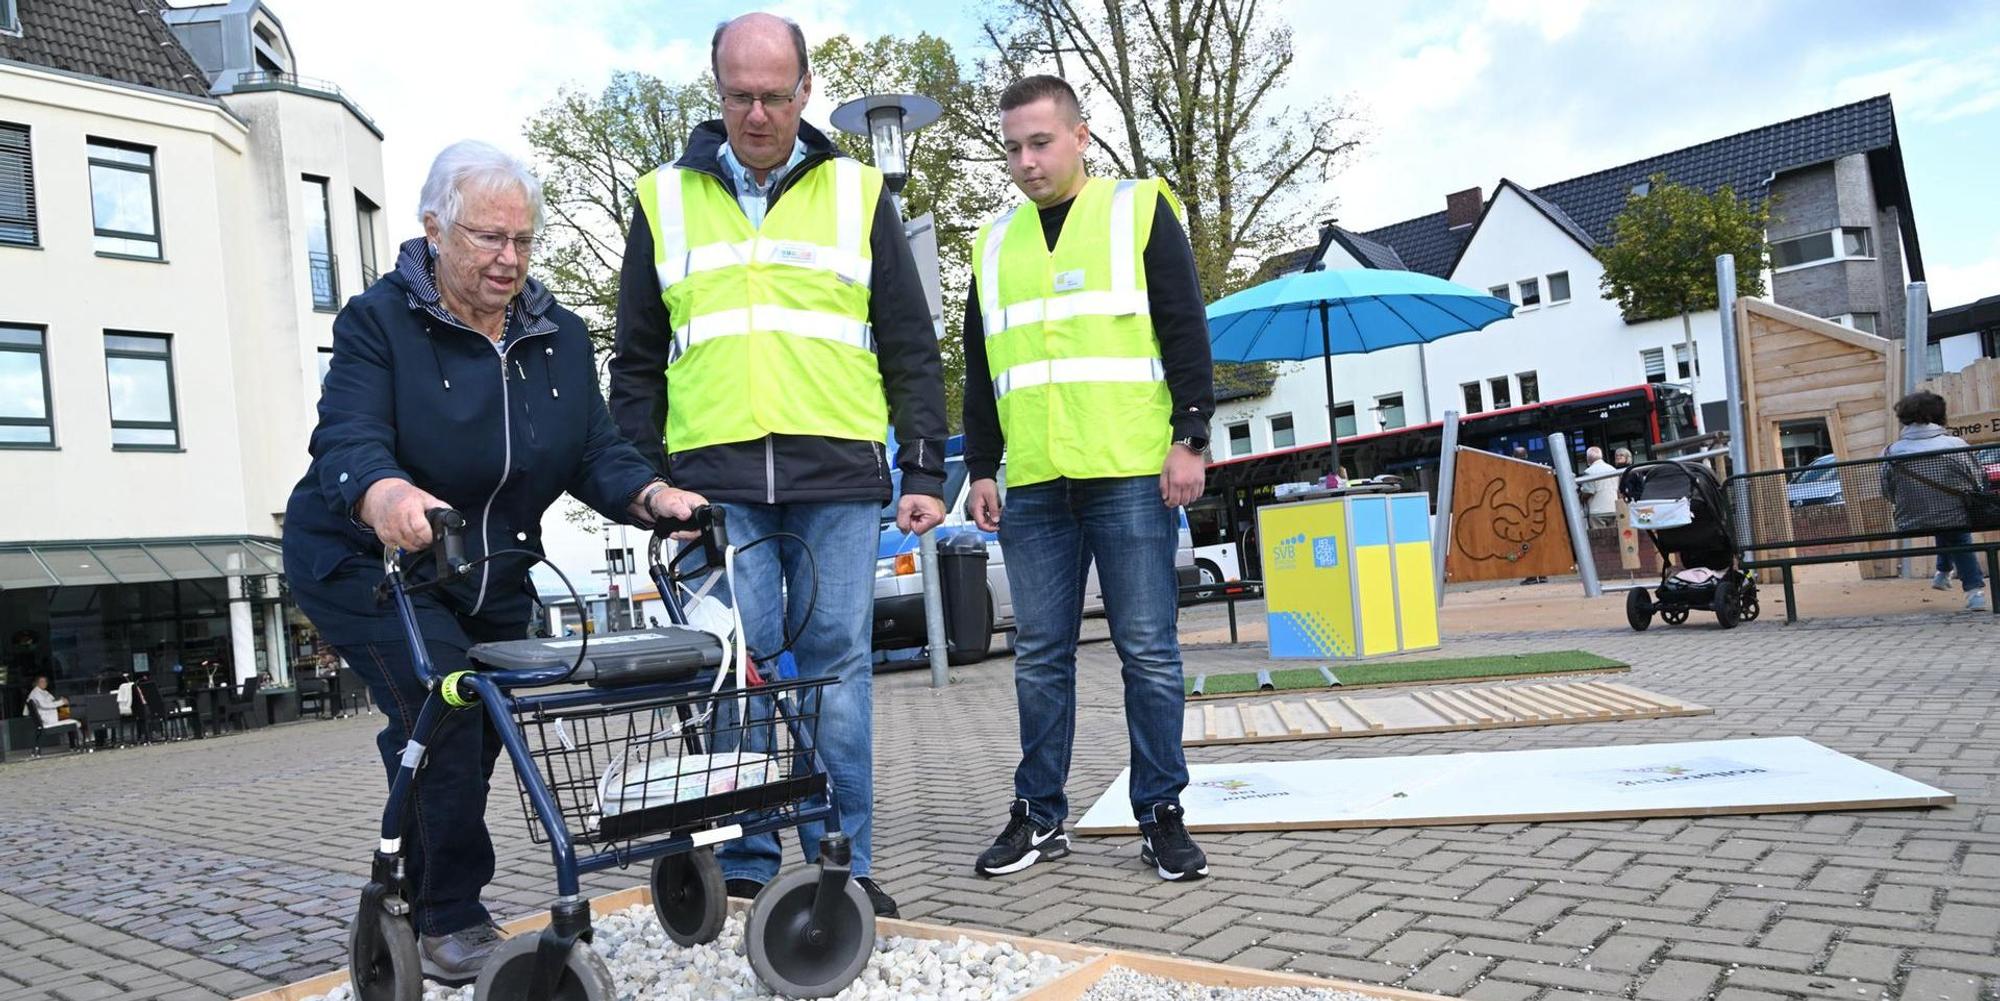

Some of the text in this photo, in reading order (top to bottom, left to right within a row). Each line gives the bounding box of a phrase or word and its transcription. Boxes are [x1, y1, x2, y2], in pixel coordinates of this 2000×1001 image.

[1609, 401, 1630, 409] MAN
[1945, 423, 1982, 437] ante
[1272, 544, 1295, 560] SVB
